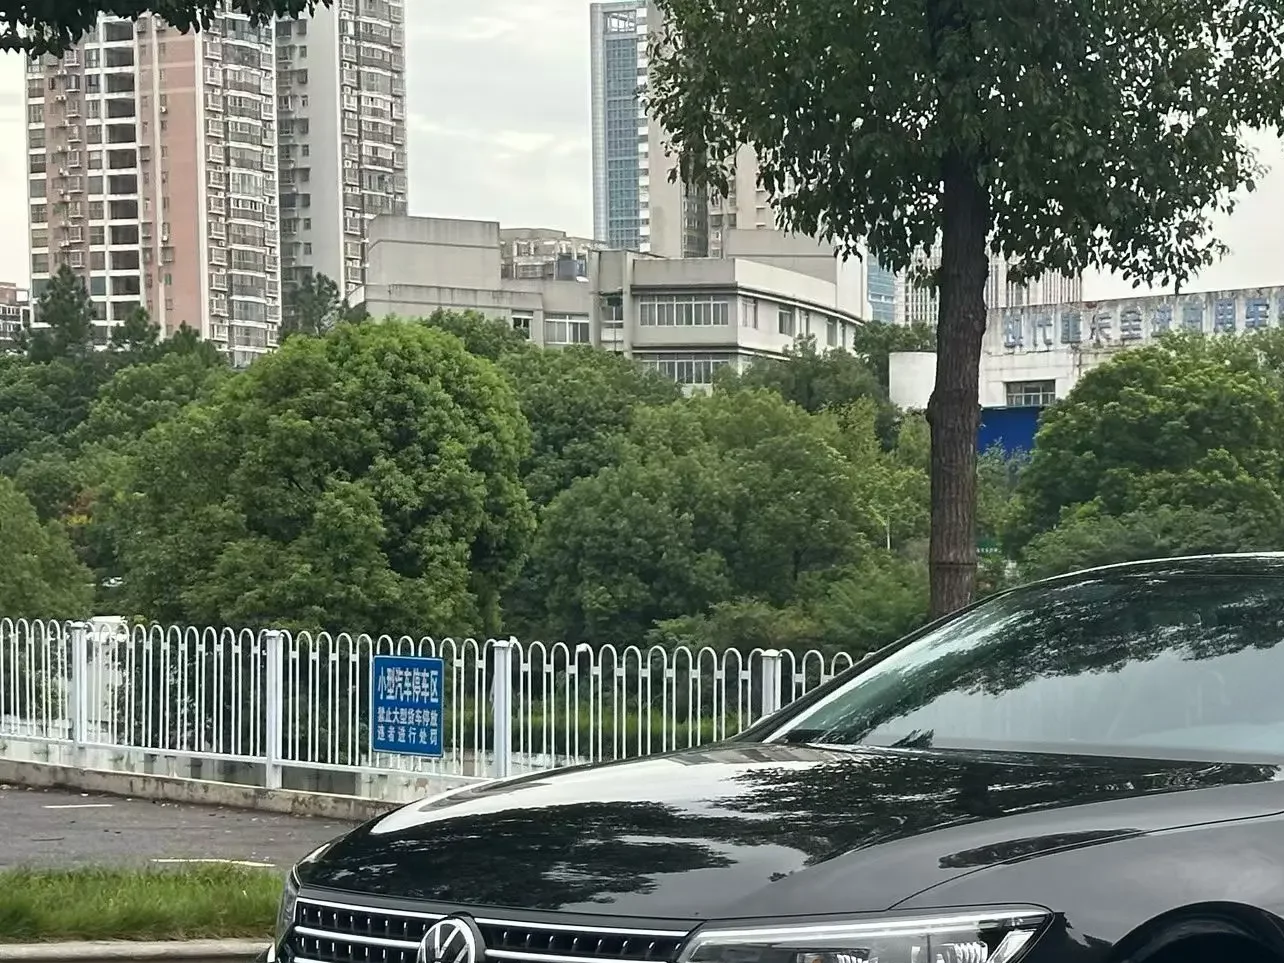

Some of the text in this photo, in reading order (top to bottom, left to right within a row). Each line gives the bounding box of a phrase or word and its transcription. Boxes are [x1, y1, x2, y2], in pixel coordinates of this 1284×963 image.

[378, 666, 439, 704] 小型汽车停车区
